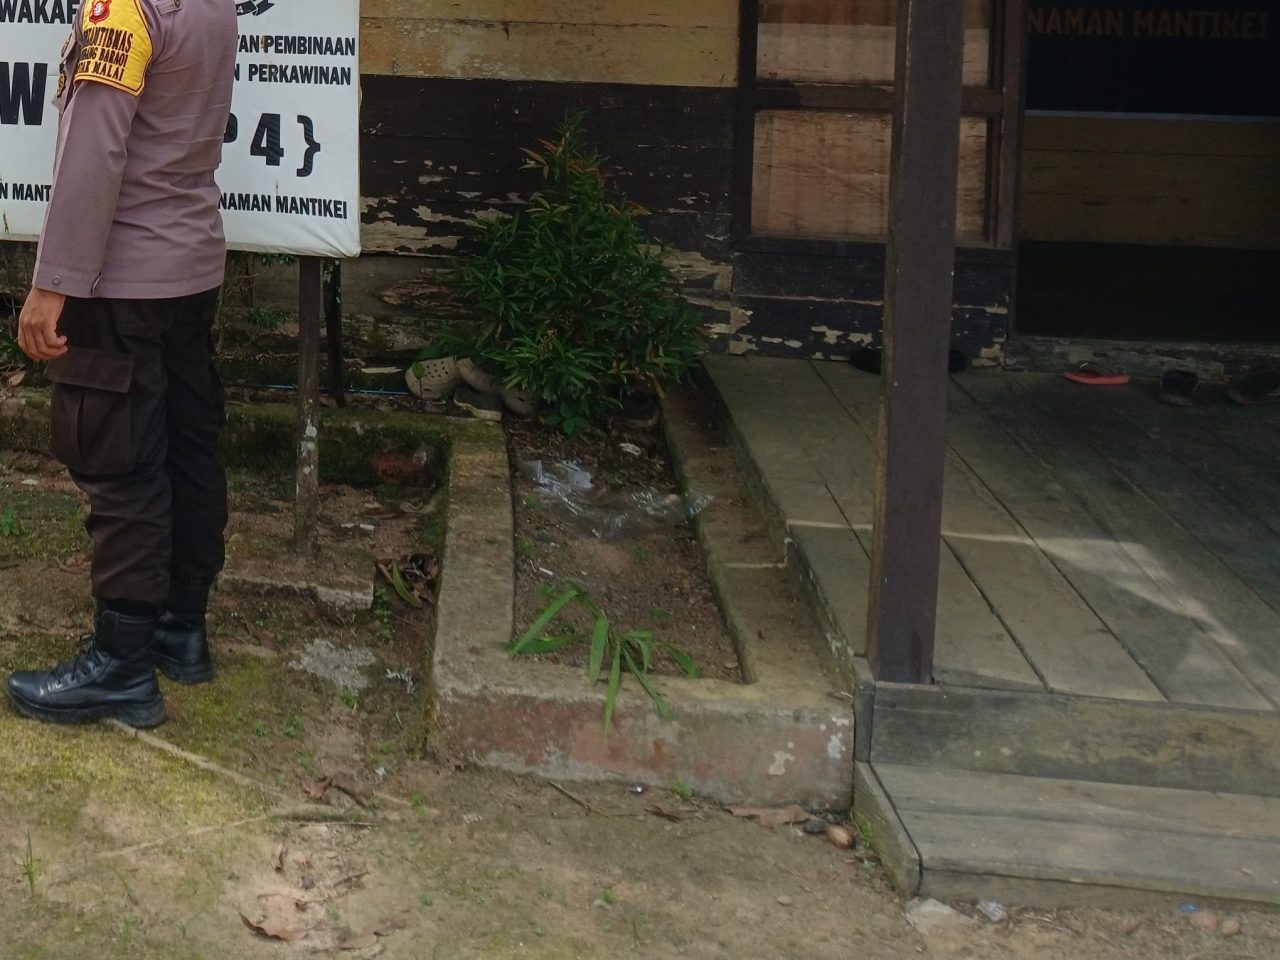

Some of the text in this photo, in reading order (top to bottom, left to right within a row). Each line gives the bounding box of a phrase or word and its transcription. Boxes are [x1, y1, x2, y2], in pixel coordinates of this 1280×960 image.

[1133, 9, 1270, 38] MANTIKEI
[262, 36, 355, 56] PEMBINAAN
[249, 64, 350, 85] PERKAWINAN
[12, 183, 51, 202] MANT
[276, 196, 347, 219] MANTIKEI
